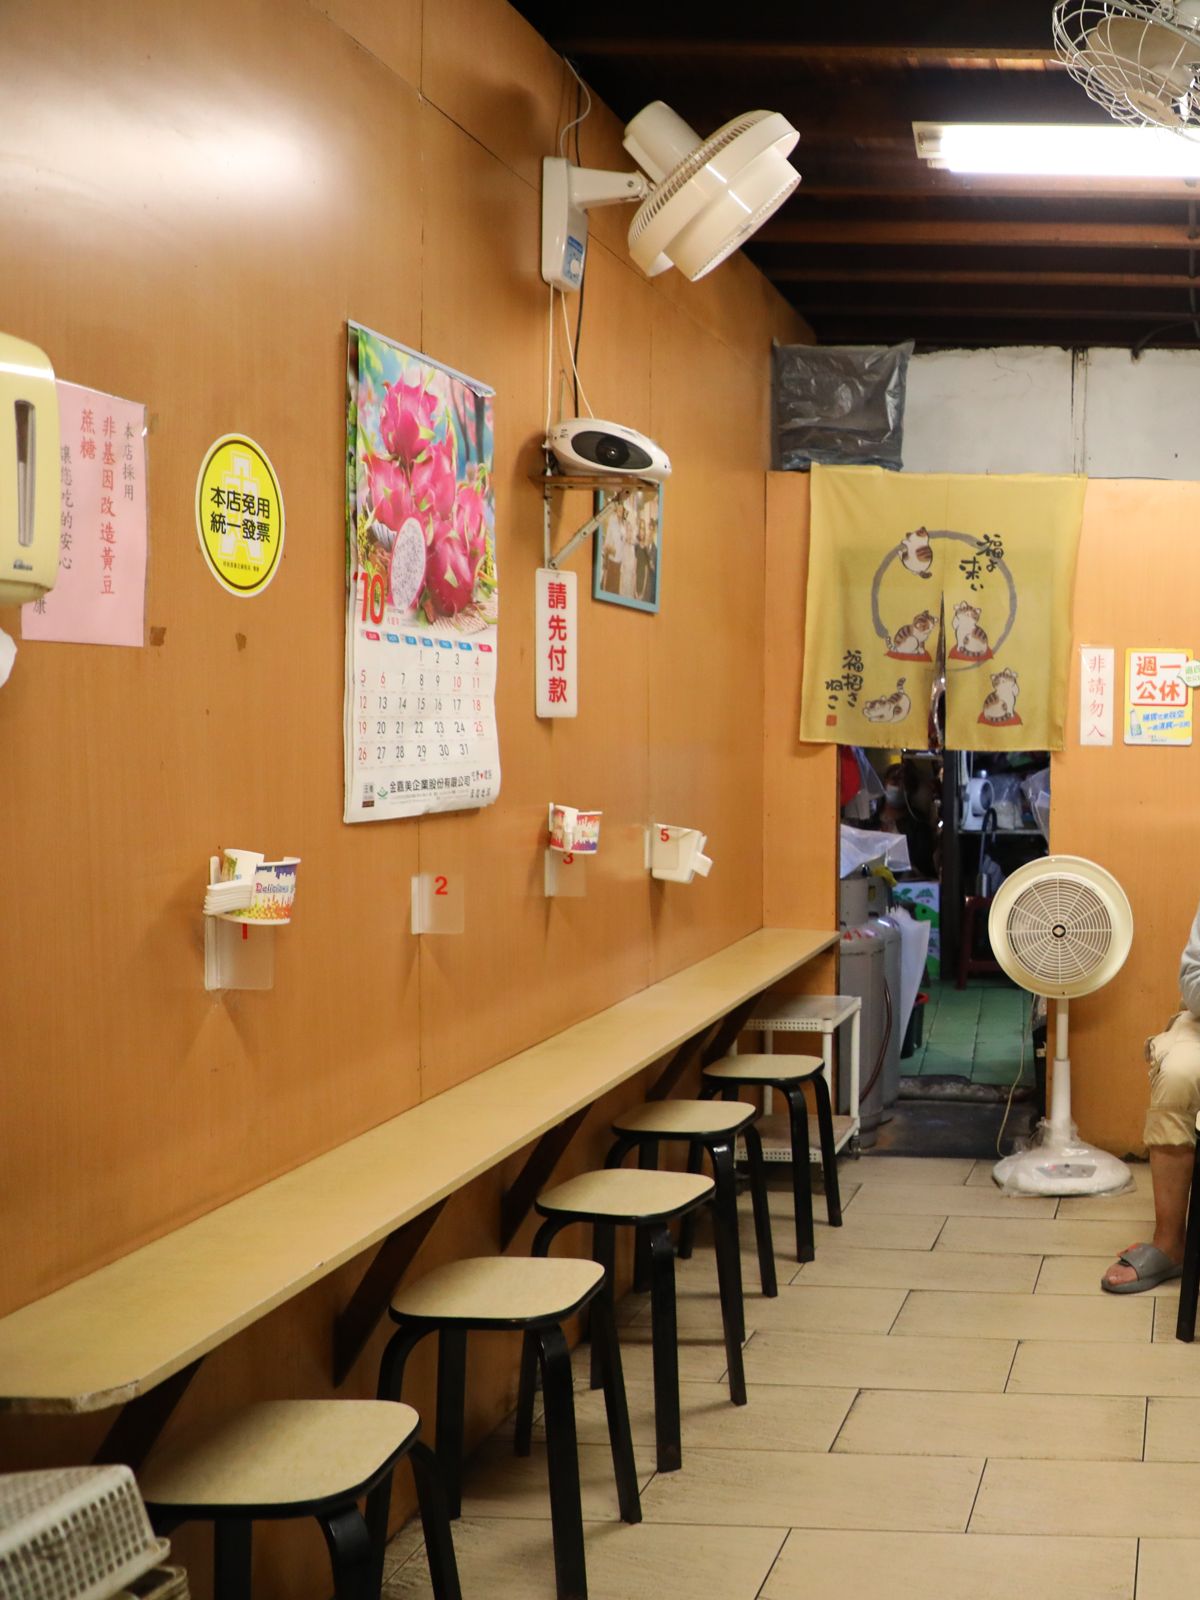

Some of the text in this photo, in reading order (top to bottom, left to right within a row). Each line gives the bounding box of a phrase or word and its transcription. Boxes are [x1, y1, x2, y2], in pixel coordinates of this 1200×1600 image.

[80, 409, 97, 460] 蔗糖
[122, 422, 135, 501] 本店採用
[100, 416, 116, 595] 非基因改造黃豆
[210, 486, 270, 519] 本店免用
[210, 512, 271, 543] 統一發票
[360, 572, 385, 625] 10
[547, 582, 568, 703] 請先付款
[419, 650, 423, 661] 1
[435, 652, 440, 664] 2
[455, 653, 460, 665] 3
[1136, 656, 1182, 676] 週一
[360, 670, 480, 688] 5 6 7 8 9 10 11
[1088, 655, 1107, 738] 非請勿入
[1136, 680, 1181, 702] 公休
[359, 696, 481, 711] 12 13 14 15 16 17 18
[359, 721, 484, 735] 19 20 21 22 23 24 25
[358, 743, 470, 760] 26 27 28 29 30 31
[660, 828, 670, 842] 5
[563, 851, 574, 865] 3
[434, 875, 448, 896] 2
